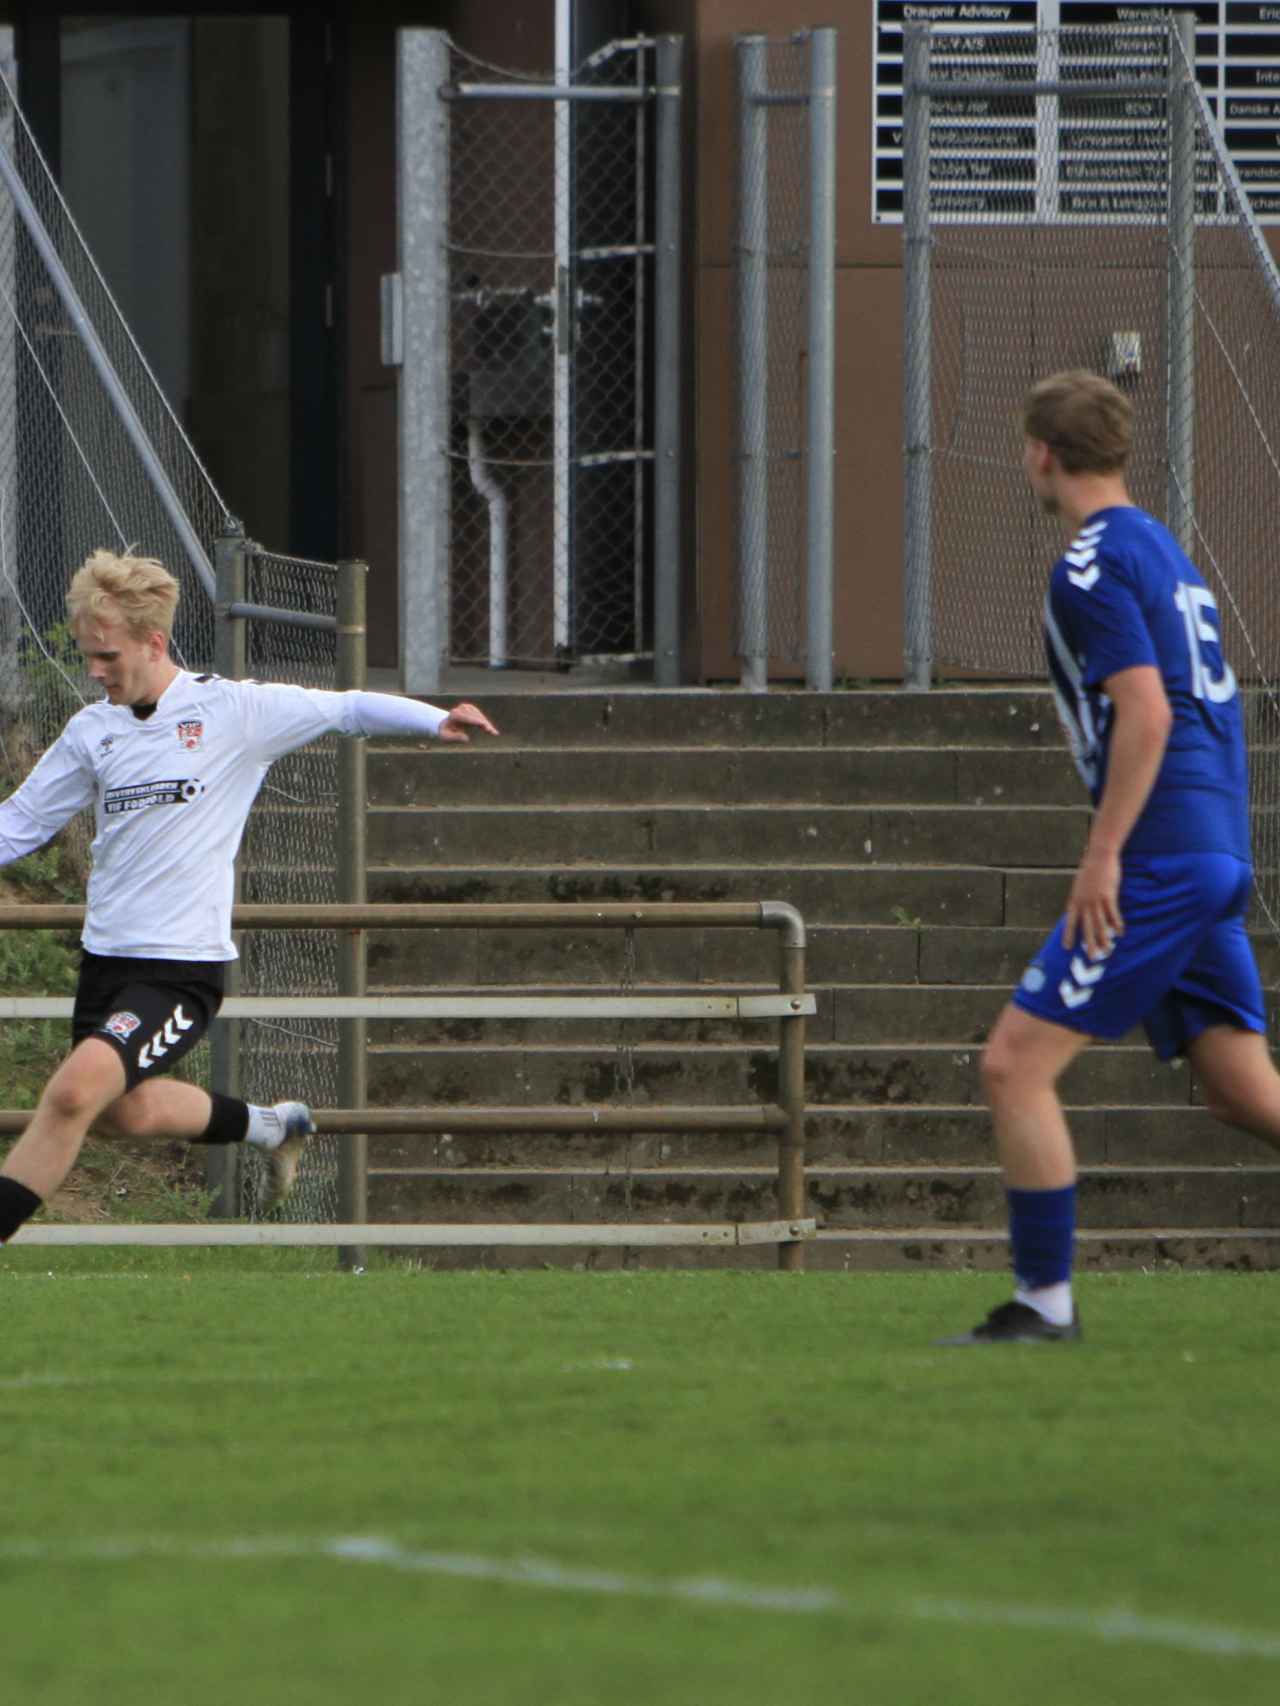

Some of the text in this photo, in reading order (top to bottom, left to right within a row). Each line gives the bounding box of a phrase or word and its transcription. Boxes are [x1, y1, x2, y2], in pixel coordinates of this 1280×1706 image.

[903, 5, 1011, 19] Draupnir Advisory
[1230, 104, 1270, 115] Danske
[1174, 582, 1236, 703] 15
